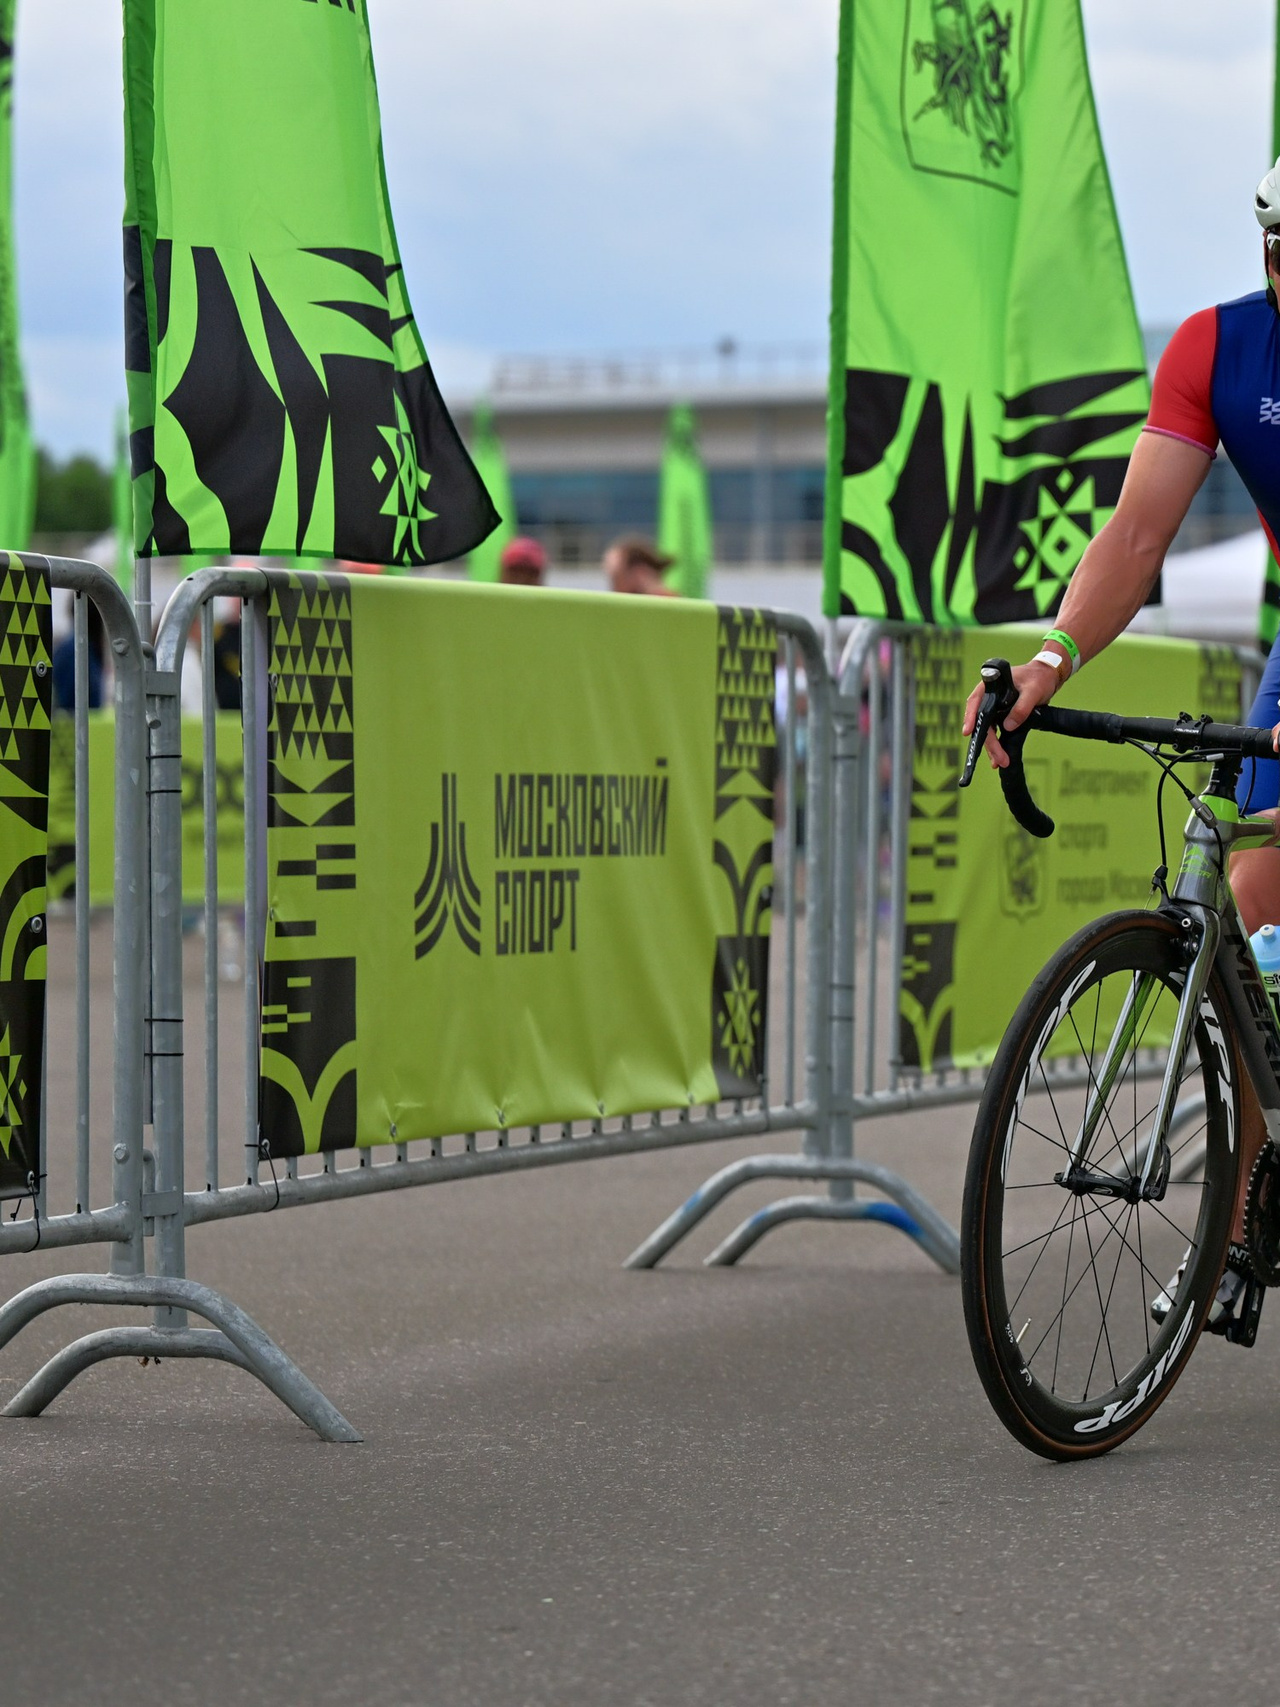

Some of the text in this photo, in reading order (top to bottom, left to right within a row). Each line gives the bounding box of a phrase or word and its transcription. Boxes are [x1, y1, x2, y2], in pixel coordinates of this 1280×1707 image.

[495, 757, 669, 858] МОСКОВСКИЙ
[495, 869, 580, 956] СПОРТ
[1073, 1299, 1196, 1433] ZIPP
